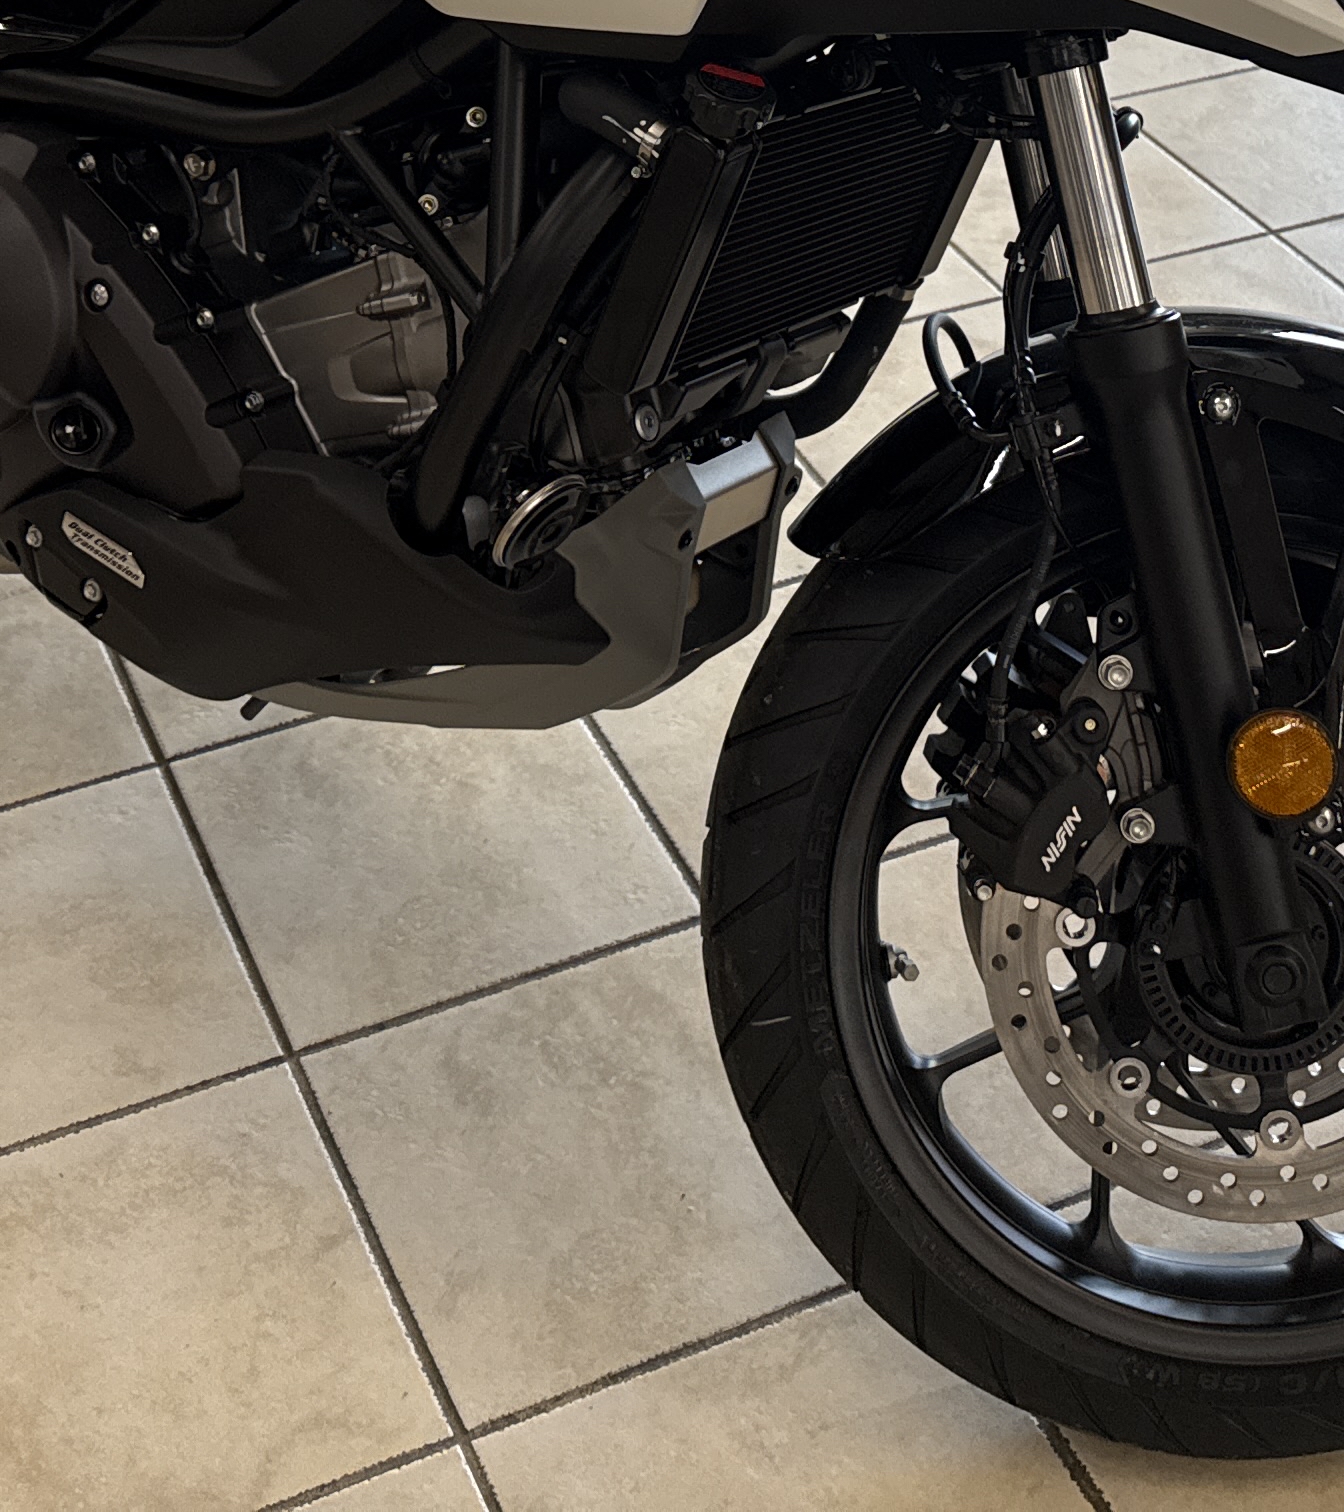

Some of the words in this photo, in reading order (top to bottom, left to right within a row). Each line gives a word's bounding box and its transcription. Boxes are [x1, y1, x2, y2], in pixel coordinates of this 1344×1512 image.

[68, 521, 95, 540] Dual
[94, 538, 127, 563] Clutch
[71, 532, 140, 581] Transmission
[799, 800, 839, 1054] METZELER
